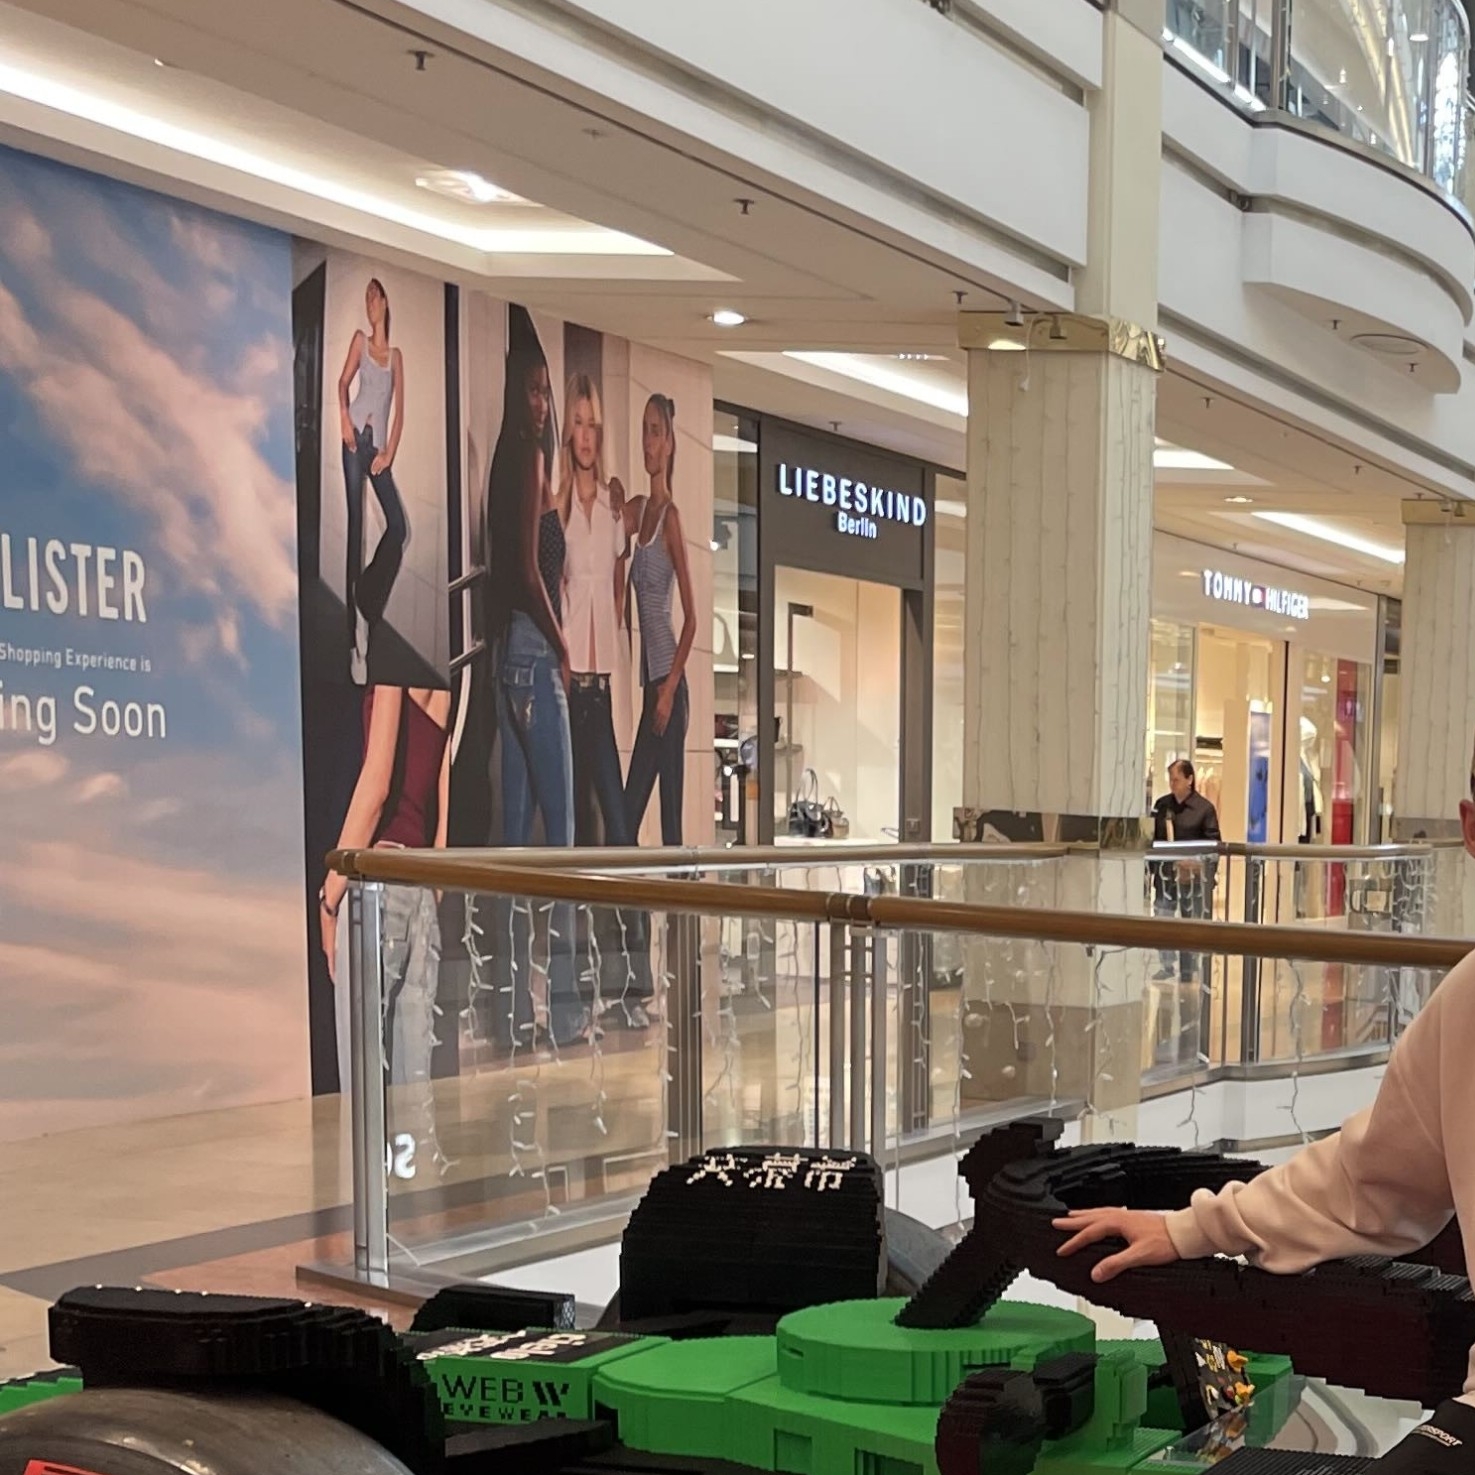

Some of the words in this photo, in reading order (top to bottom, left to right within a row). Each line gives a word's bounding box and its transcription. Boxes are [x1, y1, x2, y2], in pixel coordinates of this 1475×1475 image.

[779, 463, 927, 527] LIEBESKIND
[837, 511, 877, 539] Berlin
[1, 533, 147, 623] LISTER
[1203, 569, 1252, 605] TOMMY
[1265, 586, 1309, 620] HILFIGER
[0, 642, 62, 669] Shopping
[65, 647, 137, 671] Experience
[140, 653, 151, 672] is
[73, 685, 167, 739] Soon
[442, 1373, 524, 1404] WEB
